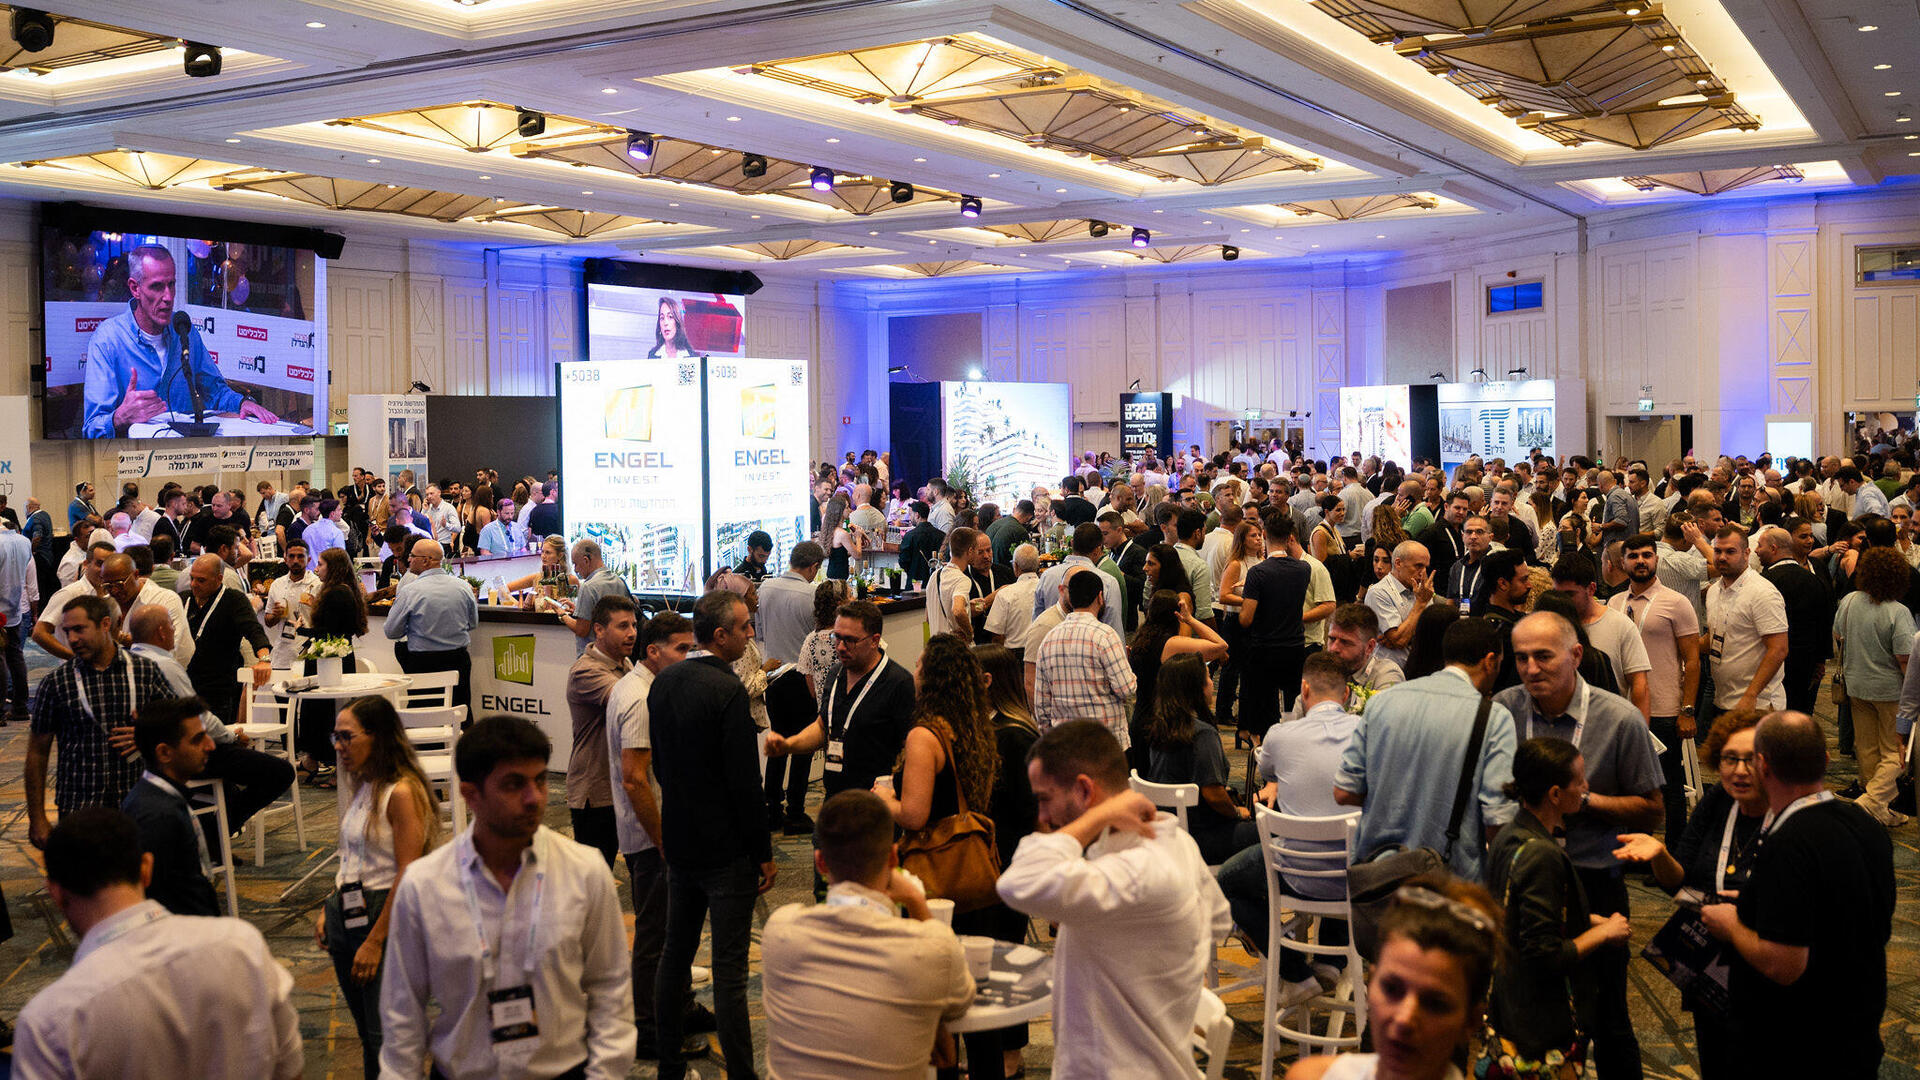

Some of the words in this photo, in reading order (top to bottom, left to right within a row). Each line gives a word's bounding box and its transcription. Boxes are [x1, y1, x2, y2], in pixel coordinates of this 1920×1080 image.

[238, 327, 266, 340] כלכליסט
[288, 367, 314, 380] לכליסט
[1124, 411, 1157, 420] הבאים
[594, 452, 674, 469] ENGEL
[735, 449, 790, 467] ENGEL
[168, 462, 190, 471] רמלה
[191, 461, 204, 469] את
[268, 459, 287, 468] קצרין
[608, 475, 660, 485] INVEST
[744, 472, 781, 481] INVEST
[482, 695, 551, 715] ENGEL
